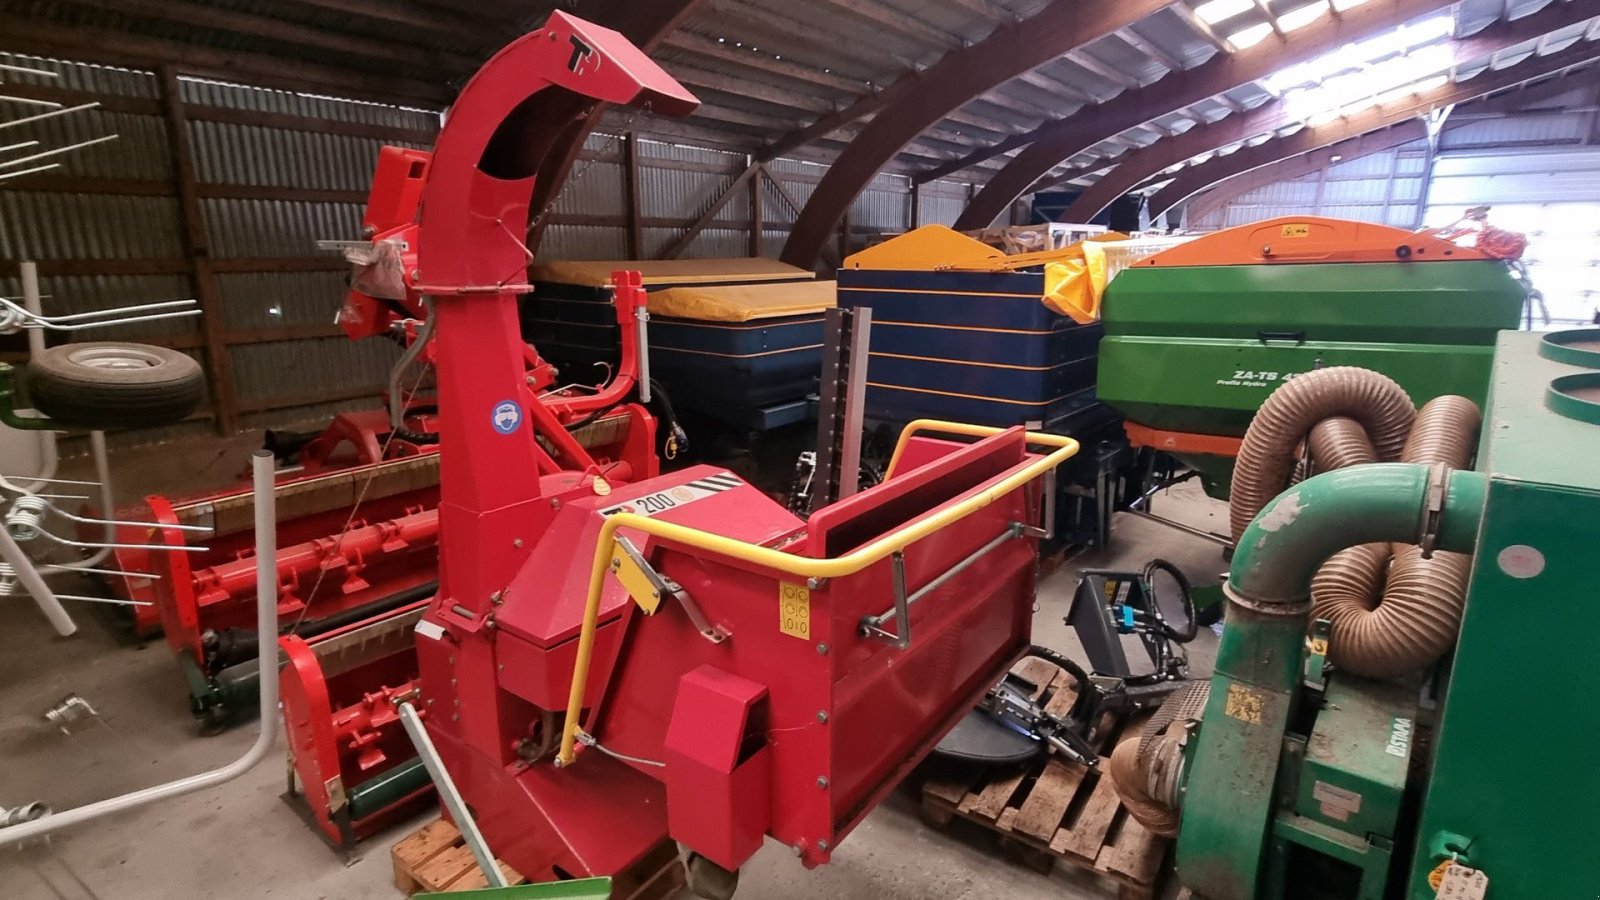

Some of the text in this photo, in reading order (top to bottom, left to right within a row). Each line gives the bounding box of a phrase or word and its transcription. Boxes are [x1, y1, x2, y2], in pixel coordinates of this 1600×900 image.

[1233, 370, 1279, 381] ZA-TS
[1242, 380, 1268, 388] Hydro
[636, 493, 676, 514] 200
